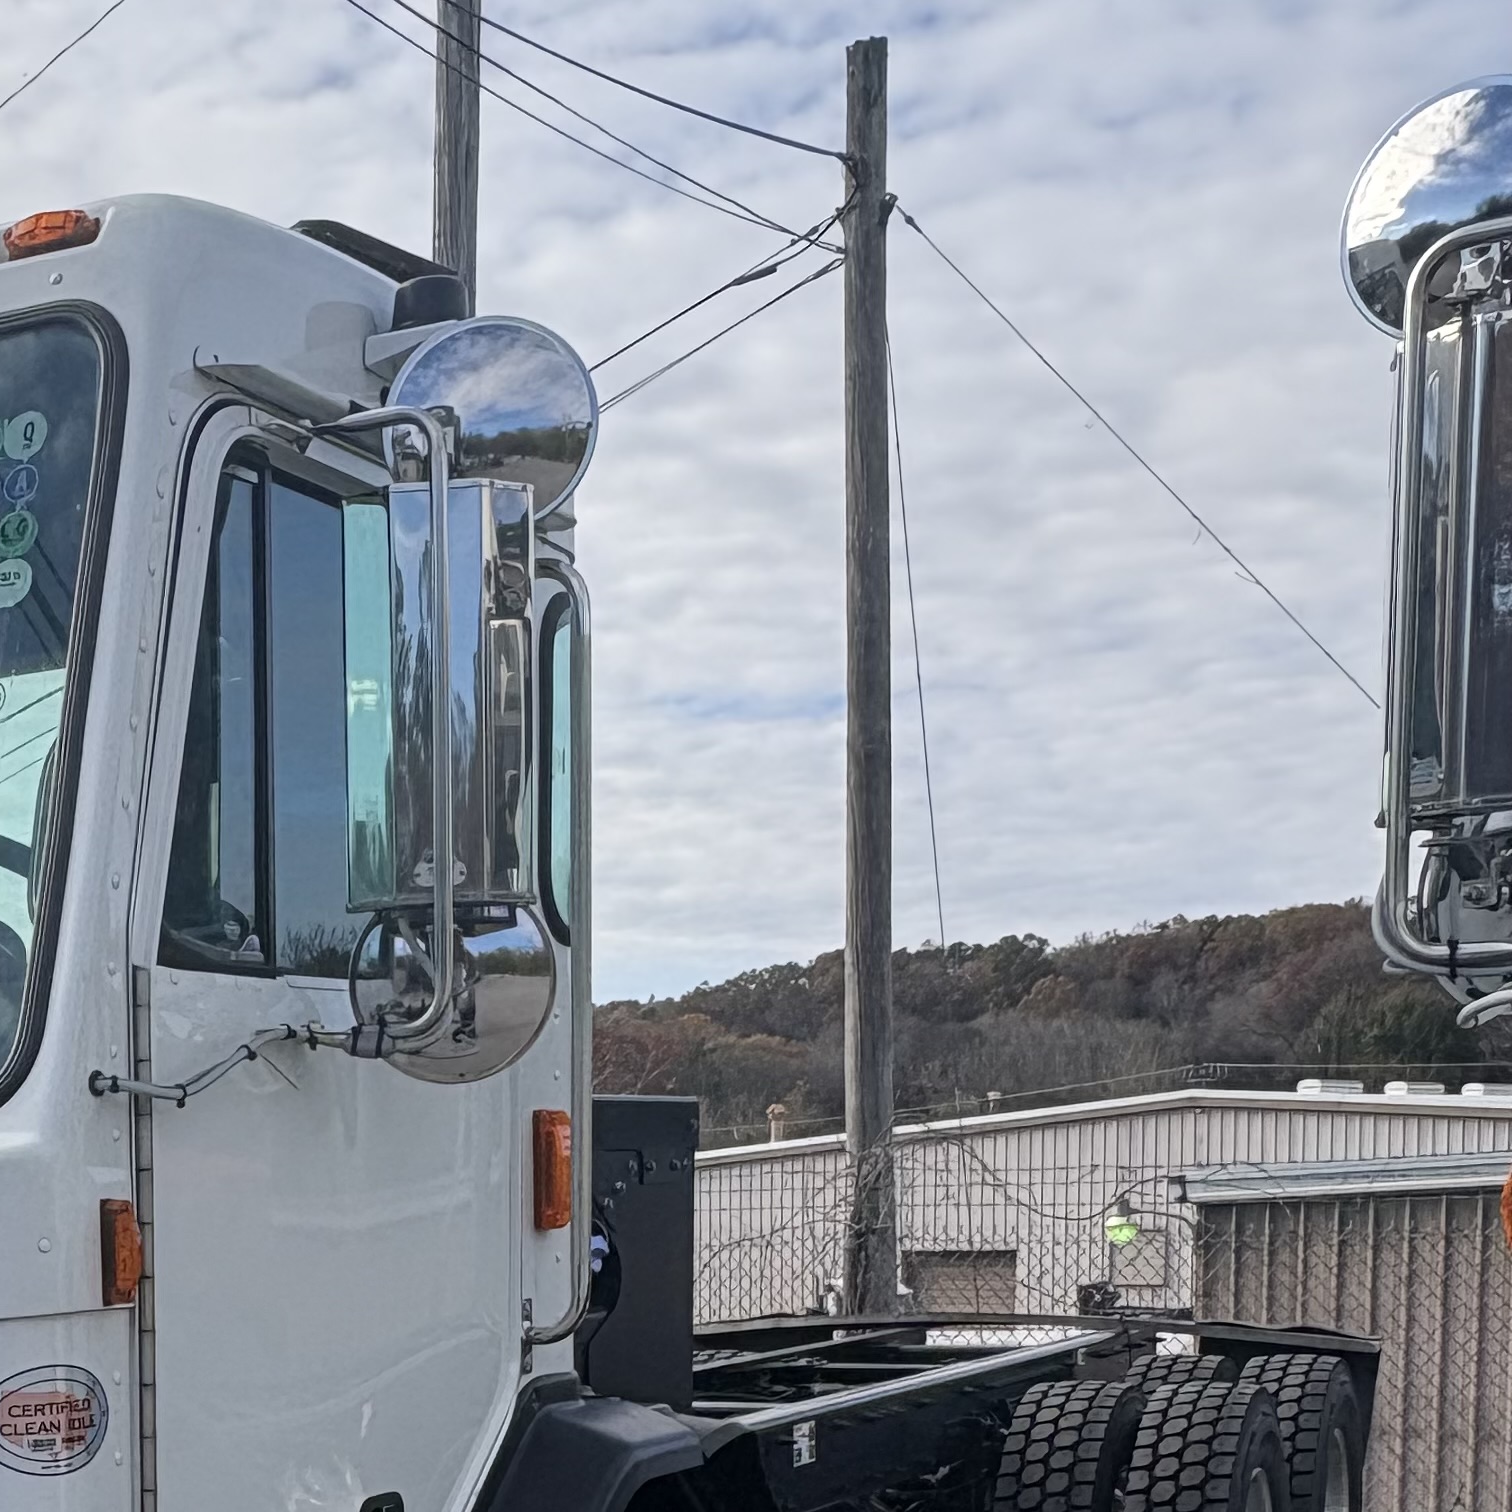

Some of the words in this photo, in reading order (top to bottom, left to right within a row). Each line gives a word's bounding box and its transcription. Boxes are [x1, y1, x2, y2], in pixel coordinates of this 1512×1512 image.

[7, 1397, 92, 1419] CERTIFIED
[0, 1418, 62, 1438] CLEAN
[67, 1413, 97, 1432] IDLE
